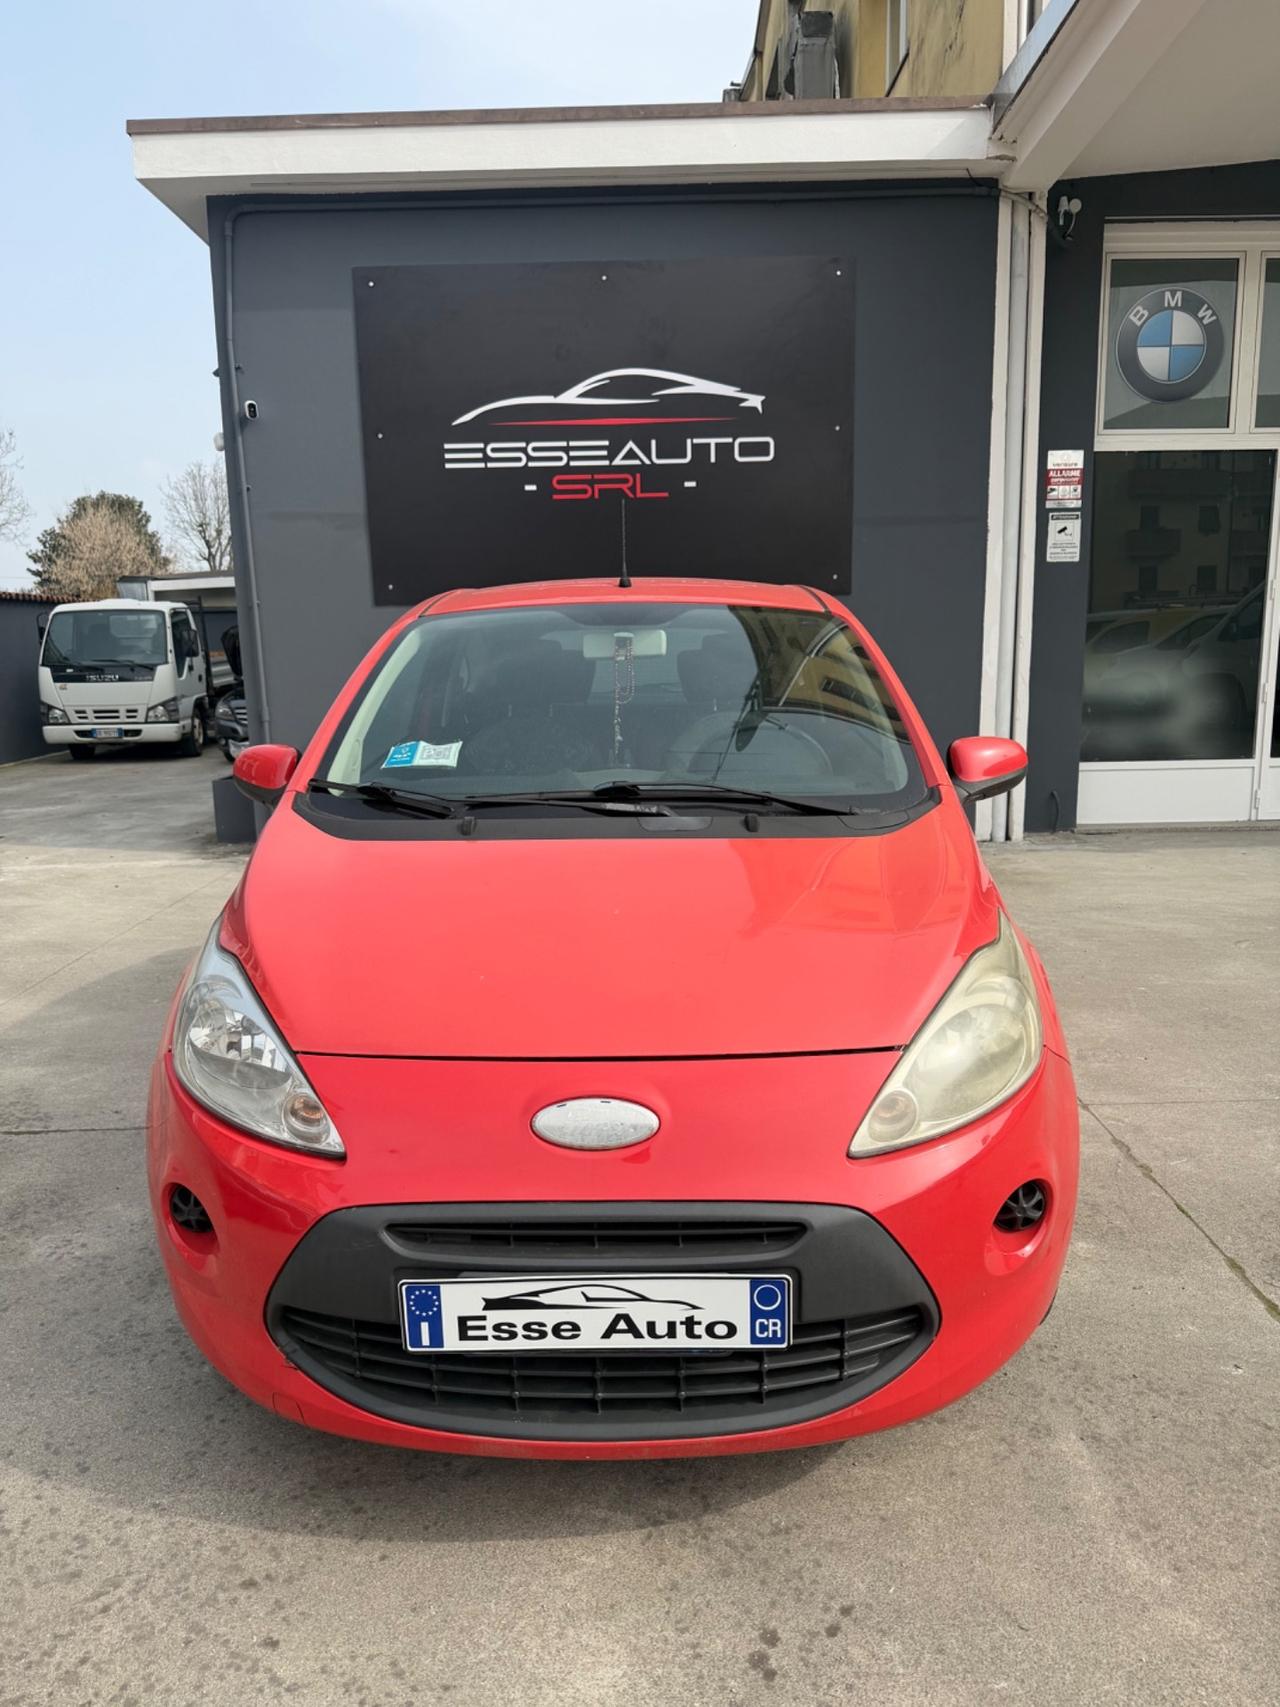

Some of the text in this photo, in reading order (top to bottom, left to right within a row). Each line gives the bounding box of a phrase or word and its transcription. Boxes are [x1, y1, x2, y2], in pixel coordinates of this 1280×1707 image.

[1129, 291, 1217, 326] BMW
[551, 473, 669, 500] SRL
[457, 1315, 581, 1341] Esse
[600, 1313, 738, 1341] Auto
[755, 1318, 782, 1338] CR
